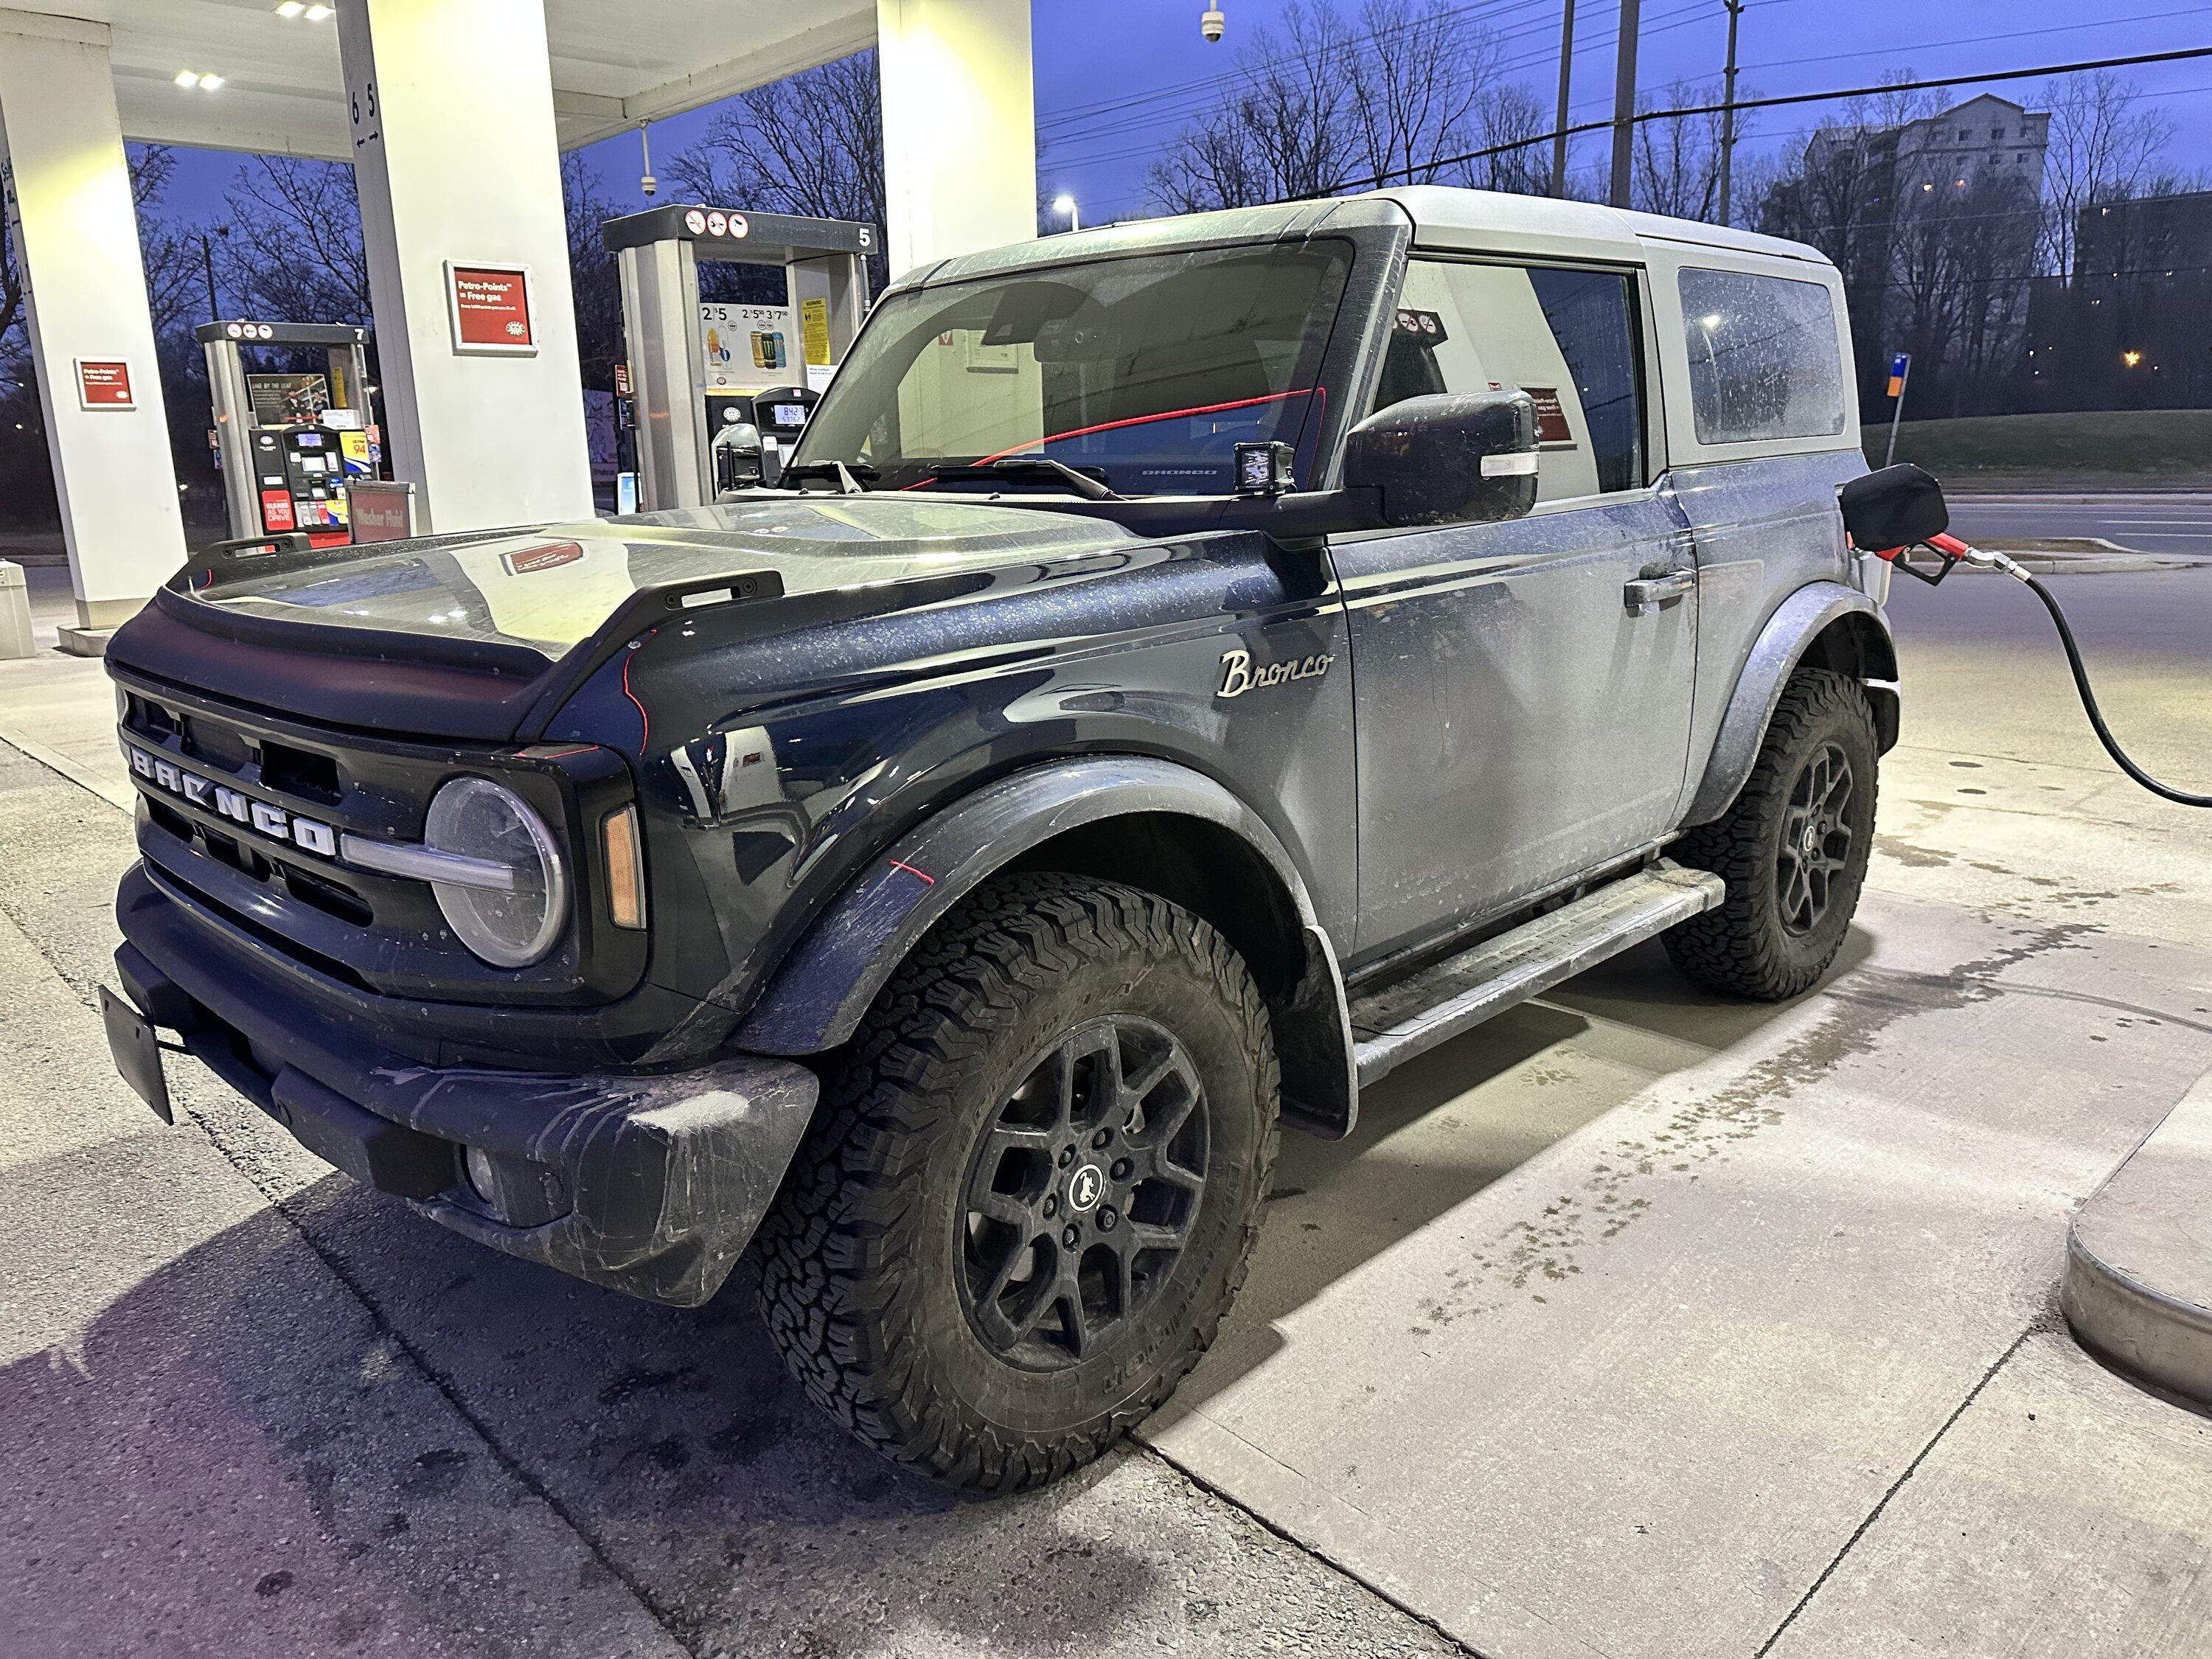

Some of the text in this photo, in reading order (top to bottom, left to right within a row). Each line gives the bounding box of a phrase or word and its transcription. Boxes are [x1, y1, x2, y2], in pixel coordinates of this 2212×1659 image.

[352, 83, 375, 125] 6 5
[859, 228, 870, 246] 5
[467, 291, 486, 300] Free
[702, 307, 712, 320] 2
[742, 309, 748, 318] 2
[767, 310, 773, 319] 3
[355, 328, 364, 340] 7
[354, 445, 366, 454] 94
[1217, 650, 1334, 698] Bronco
